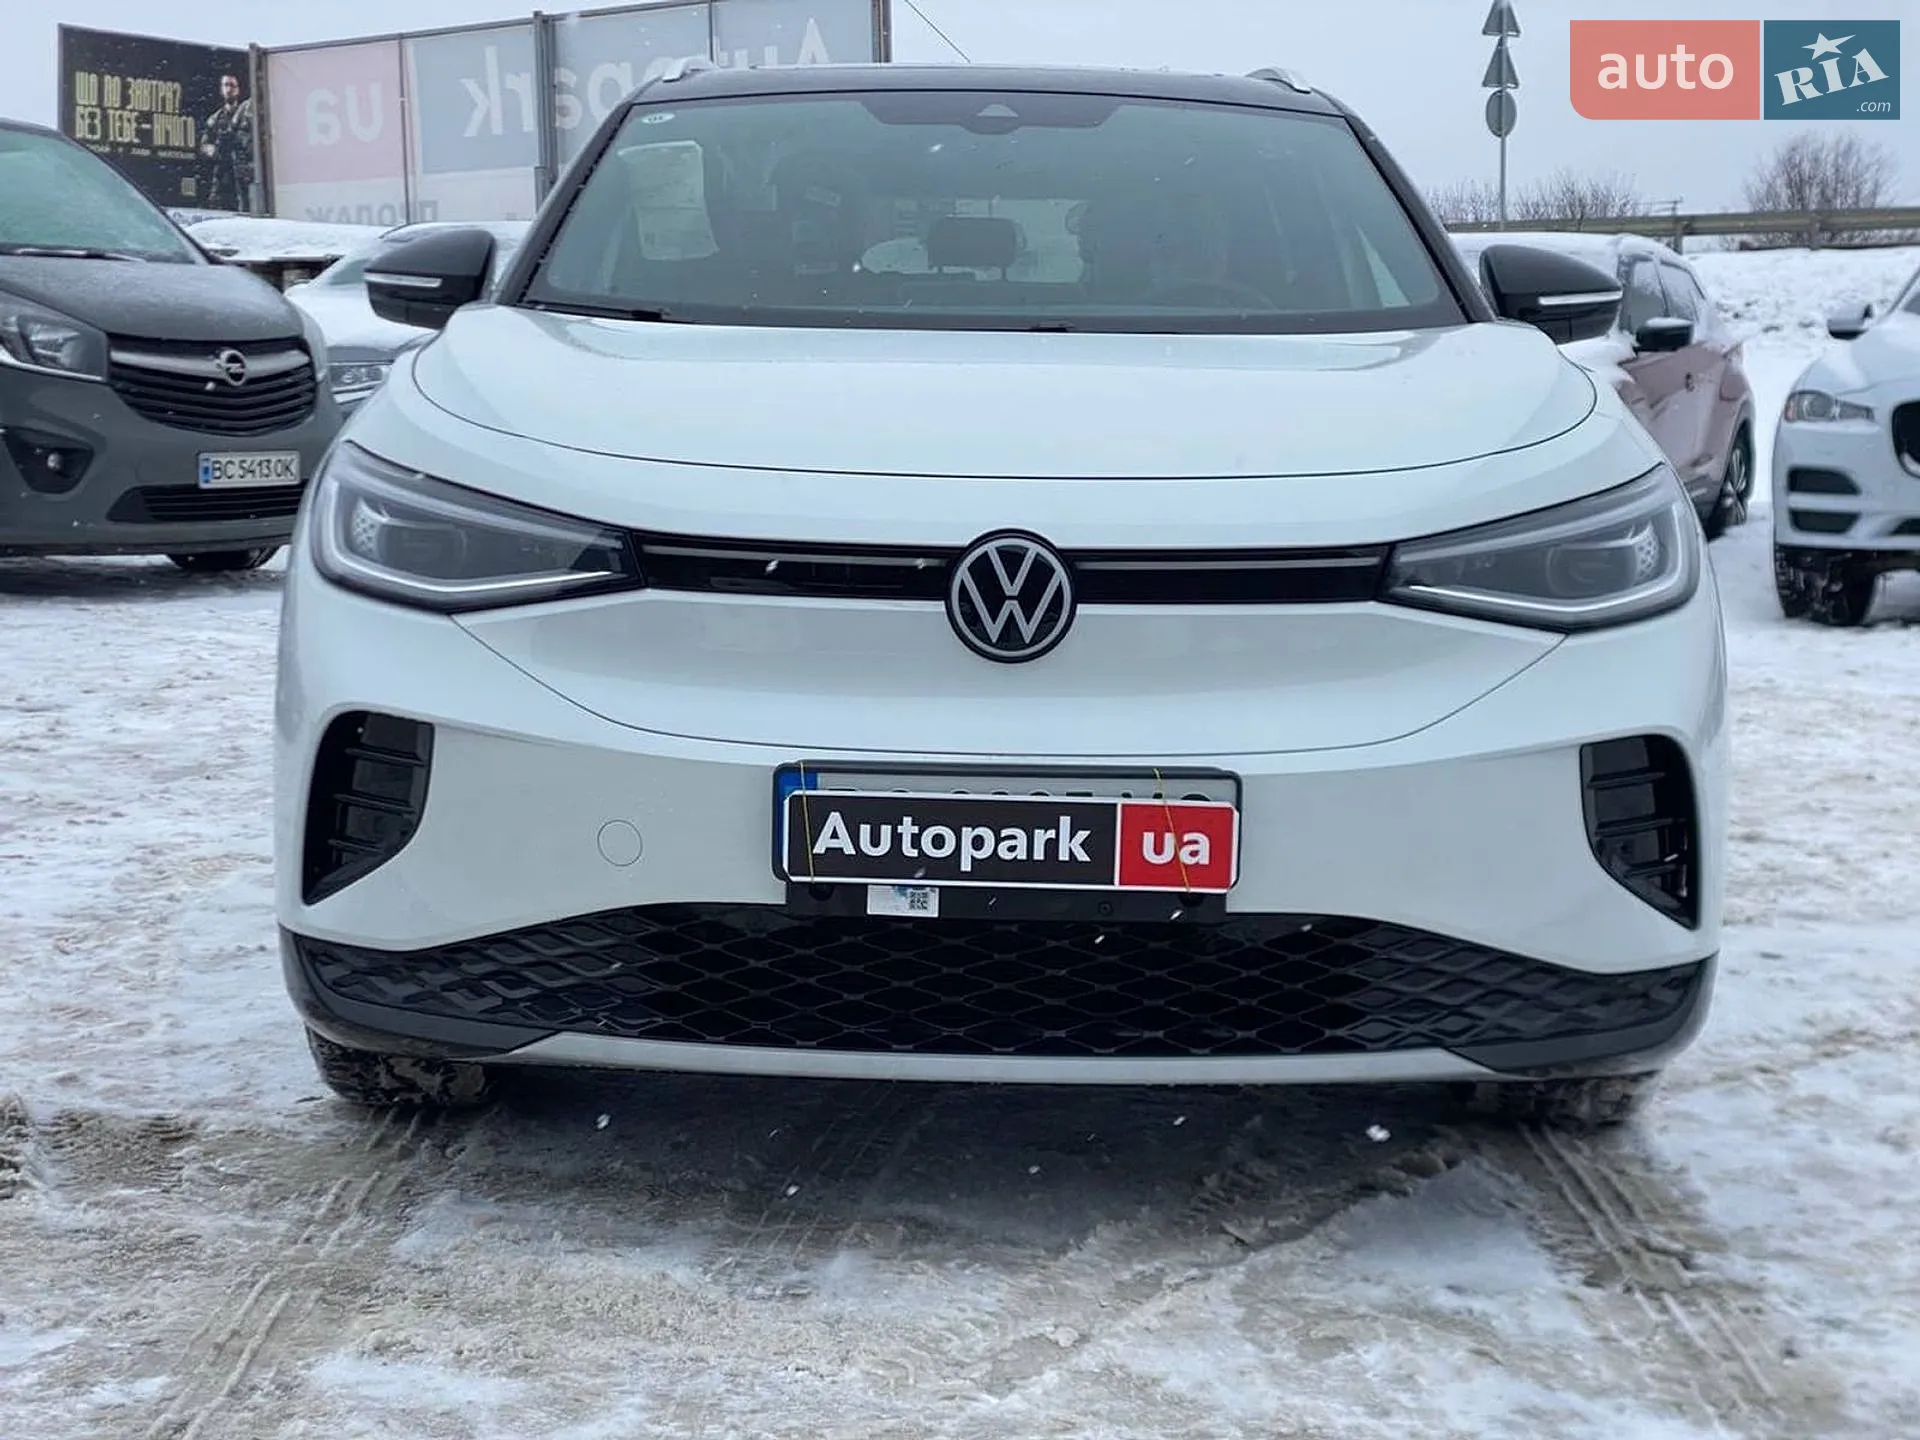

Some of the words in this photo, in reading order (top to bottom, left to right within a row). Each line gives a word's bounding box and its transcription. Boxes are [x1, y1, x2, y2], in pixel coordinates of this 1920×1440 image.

[75, 106, 101, 139] БЕЗ
[107, 109, 140, 142] ТЕБЕ
[812, 811, 1091, 872] Autopark
[1142, 828, 1211, 865] ua
